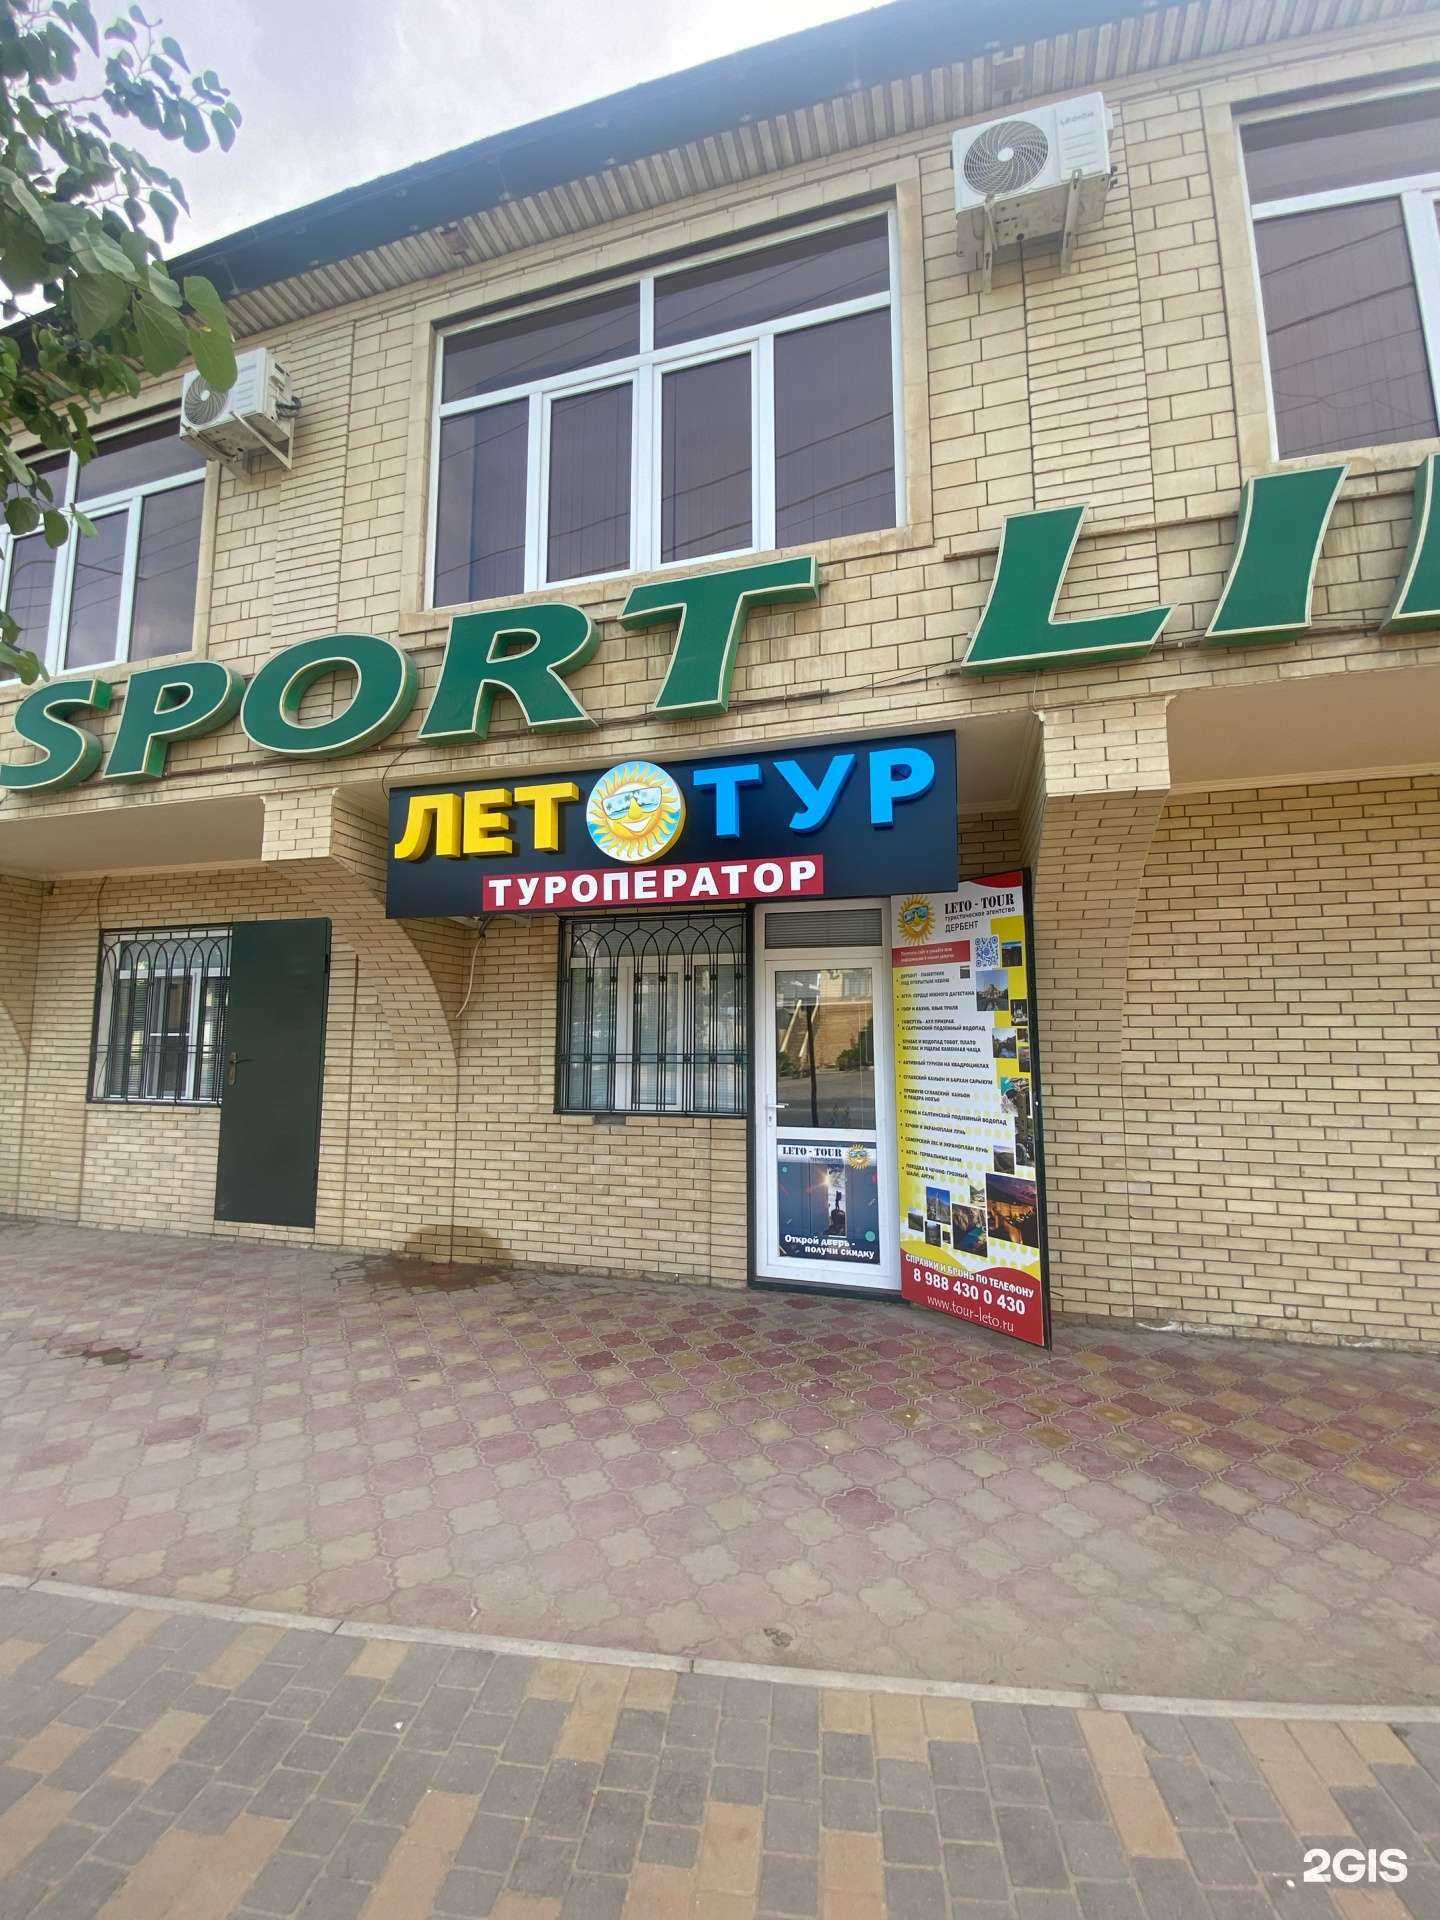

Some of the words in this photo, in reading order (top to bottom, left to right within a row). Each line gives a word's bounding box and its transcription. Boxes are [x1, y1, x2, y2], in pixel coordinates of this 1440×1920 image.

[0, 555, 820, 791] SPORT
[962, 452, 1440, 674] LI
[693, 748, 936, 839] ТУР
[489, 860, 817, 907] ТУРОПЕРАТОР
[944, 900, 972, 915] LETO
[981, 893, 1014, 909] TOUR
[945, 920, 979, 934] ДЕРБЕНТ
[782, 1146, 807, 1155] LETO
[814, 1147, 842, 1157] TOUR
[785, 1234, 819, 1245] Открой
[821, 1238, 850, 1248] дверь
[805, 1245, 838, 1255] получи
[840, 1248, 875, 1259] скидку
[905, 1254, 940, 1271] СПРАВКИ
[946, 1265, 974, 1281] БРОНЬ
[975, 1274, 988, 1285] ПО
[988, 1277, 1034, 1298] ТЕЛЕФОНУ
[913, 1268, 921, 1282] 8
[924, 1272, 949, 1291] 988
[953, 1281, 979, 1300] 430
[983, 1289, 992, 1304] 0
[997, 1294, 1026, 1315] 430
[927, 1295, 1015, 1333] www.tour-leto.ru
